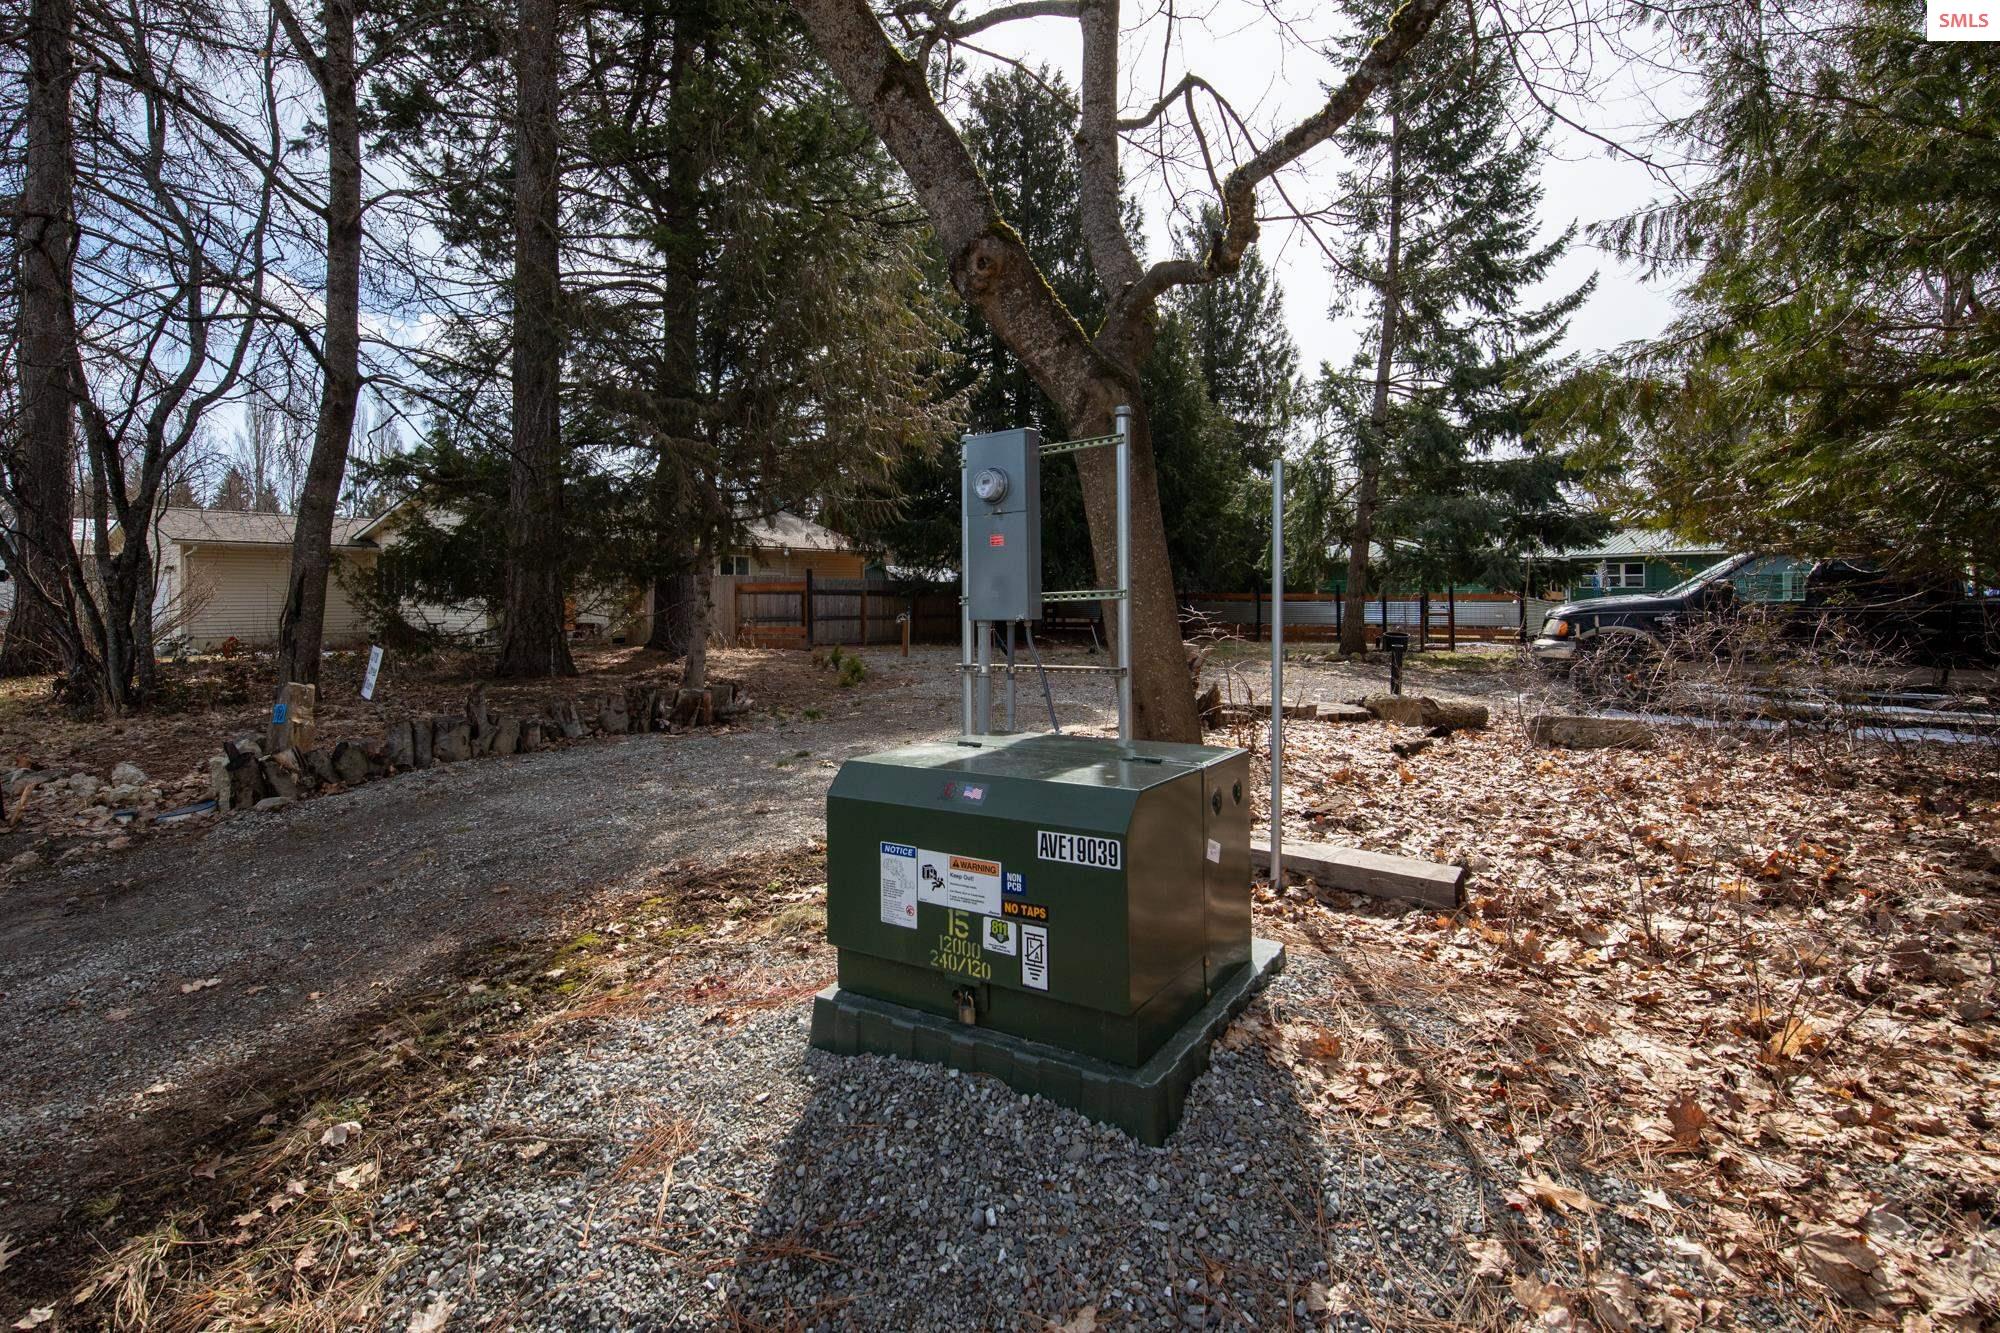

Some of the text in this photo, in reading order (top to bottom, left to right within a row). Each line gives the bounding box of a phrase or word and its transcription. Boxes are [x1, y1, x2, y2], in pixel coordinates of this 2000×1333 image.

[884, 844, 914, 857] NOTICE
[1040, 832, 1118, 867] AVE19039
[950, 872, 962, 880] Keep
[960, 861, 997, 874] WARNING
[1006, 872, 1022, 882] NON
[1007, 881, 1022, 892] PCB
[1004, 901, 1019, 915] NO
[1020, 904, 1047, 919] TAPS
[948, 908, 969, 939] 15
[991, 919, 1009, 936] 811
[939, 934, 981, 960] 12000
[930, 948, 992, 980] 240/120
